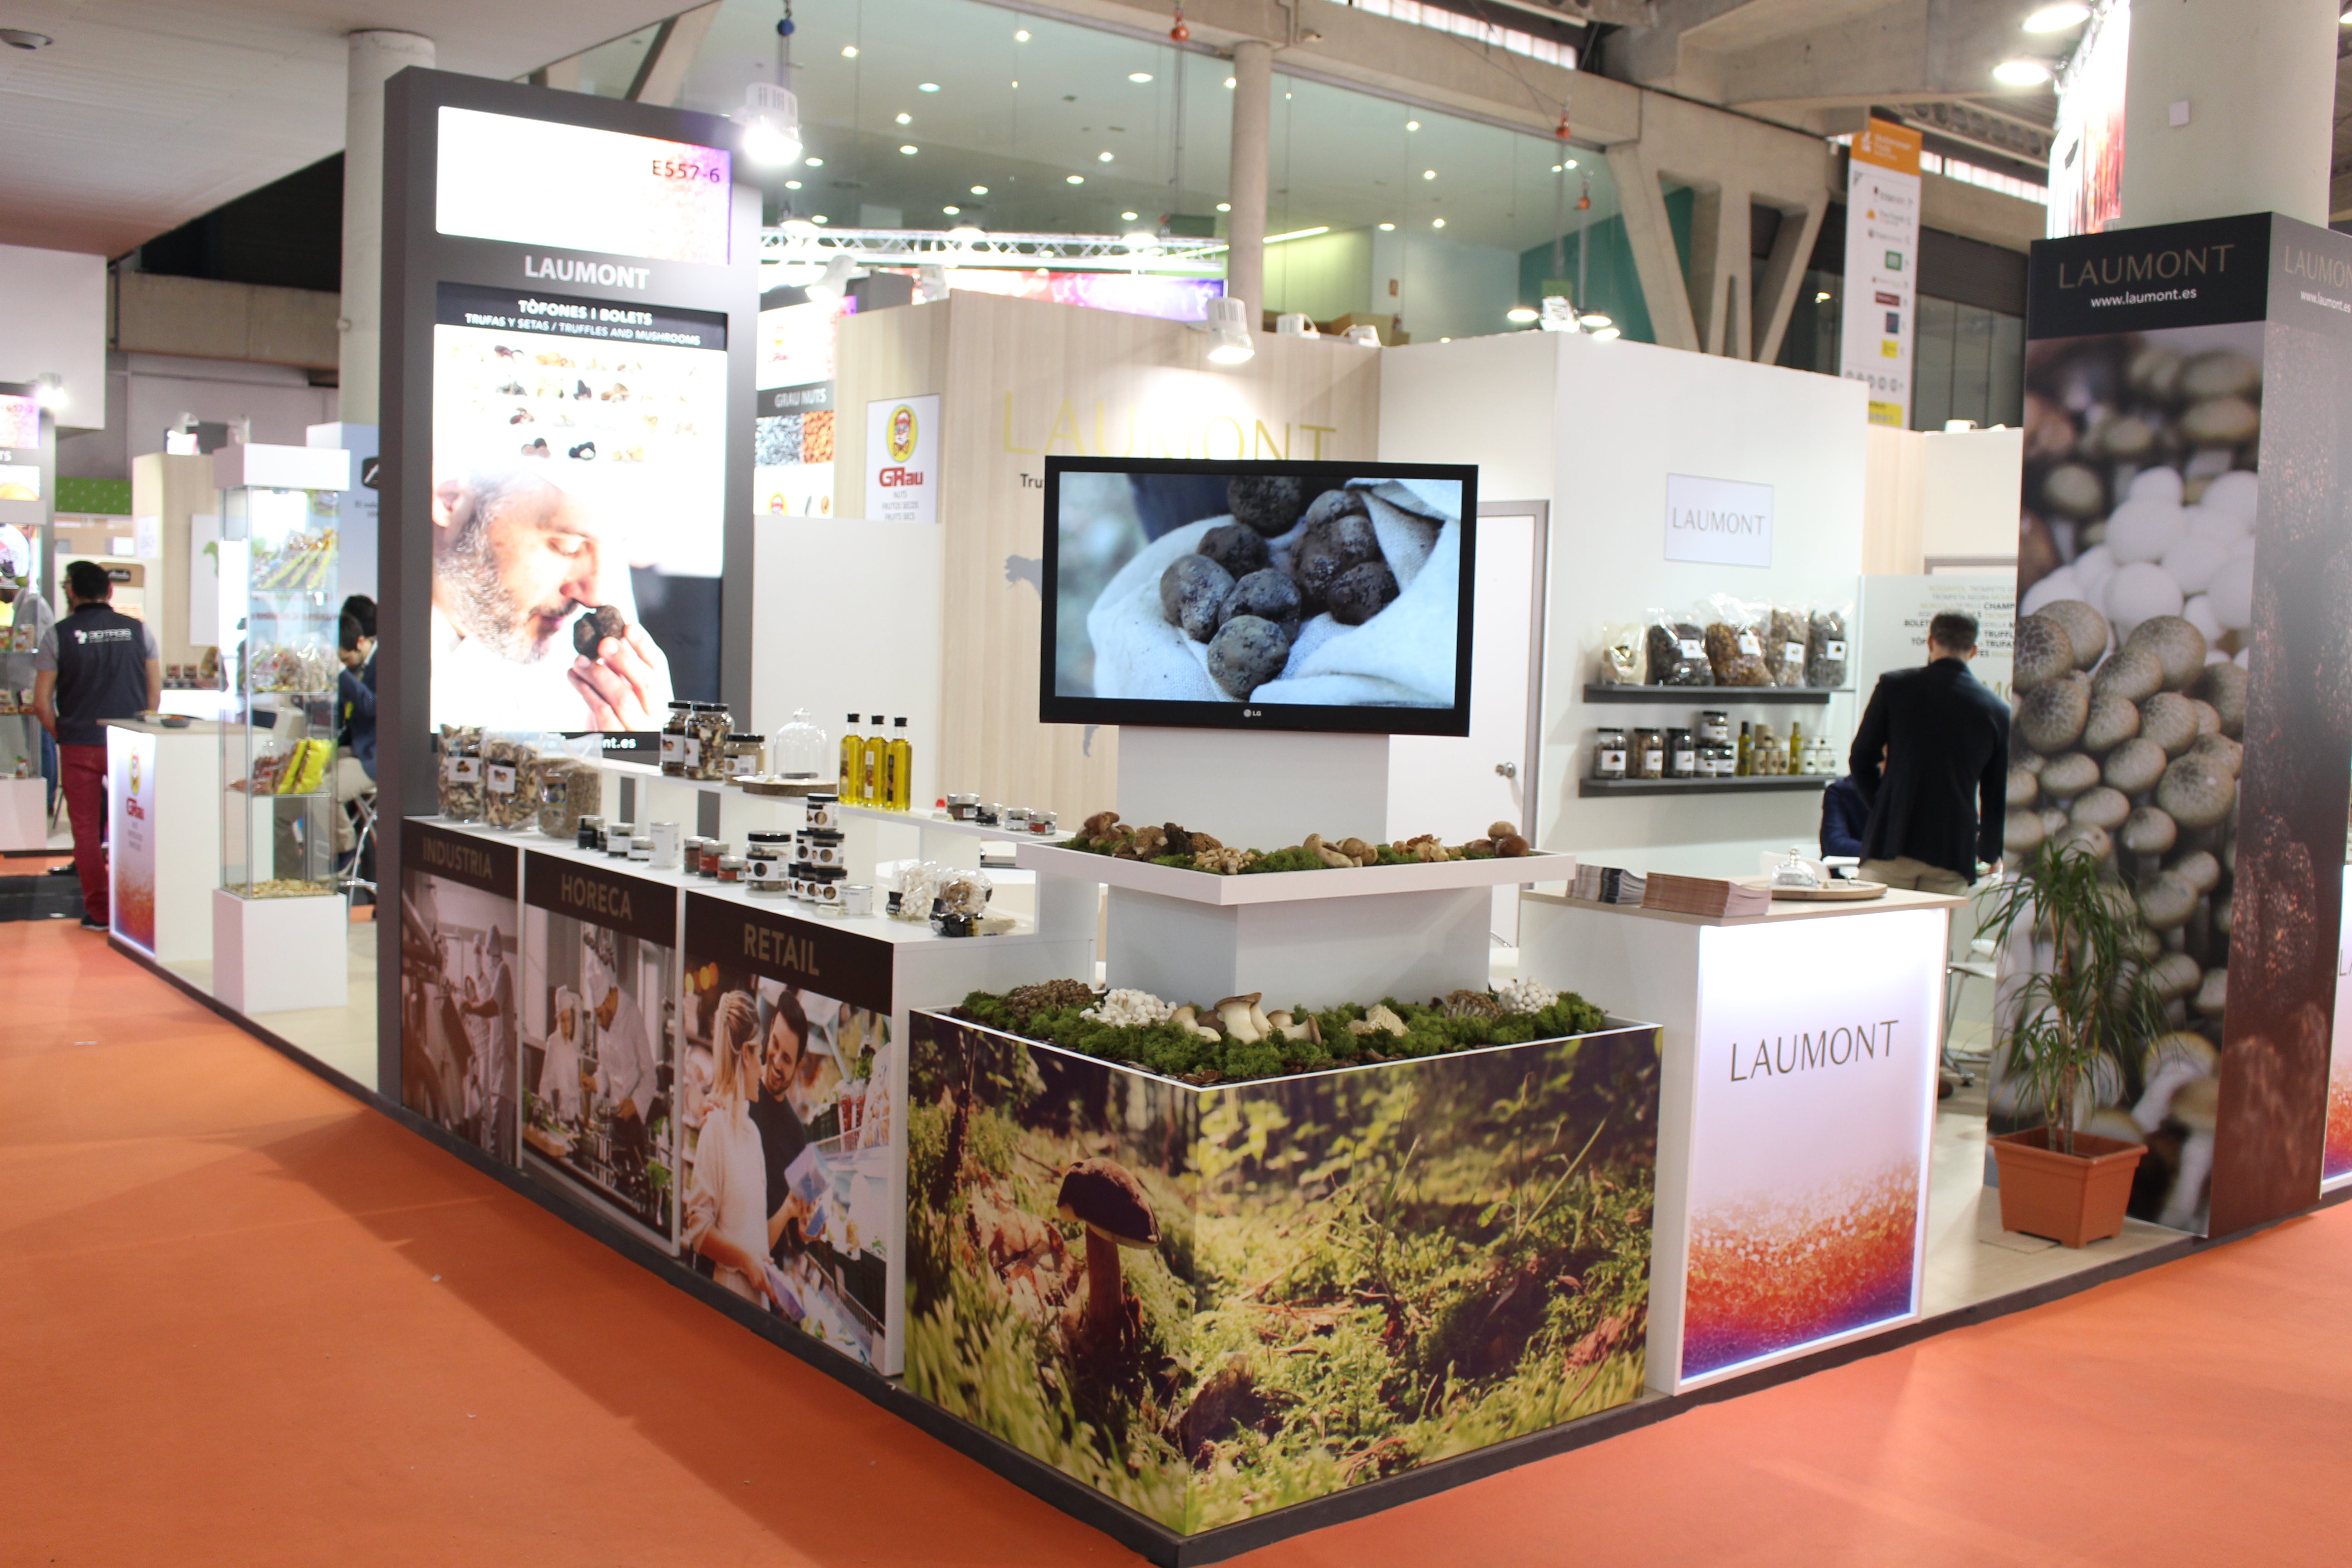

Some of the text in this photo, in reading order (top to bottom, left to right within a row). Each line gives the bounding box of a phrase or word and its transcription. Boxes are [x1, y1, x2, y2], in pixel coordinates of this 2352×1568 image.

[525, 255, 651, 290] LAUMONT
[2059, 244, 2235, 289] LAUMONT
[2285, 245, 2352, 289] LAUMON
[518, 298, 653, 326] TÒFONES I BOLETS
[2091, 289, 2197, 308] www.laumont.es
[465, 313, 506, 328] TRUFAS
[508, 318, 515, 328] Y
[517, 318, 549, 332] SETAS
[559, 322, 608, 337] TRUFFLES
[610, 328, 633, 339] AND
[635, 330, 701, 346] MUSHROOMS
[1020, 473, 1043, 488] Tru
[1673, 507, 1766, 535] LAUMONT
[1986, 639, 2012, 647] TRUFA
[423, 837, 493, 880] INDUSTRIA
[561, 873, 632, 921] HORECA
[744, 923, 820, 976] RETAIL
[1730, 1019, 1899, 1083] LAUMONT
